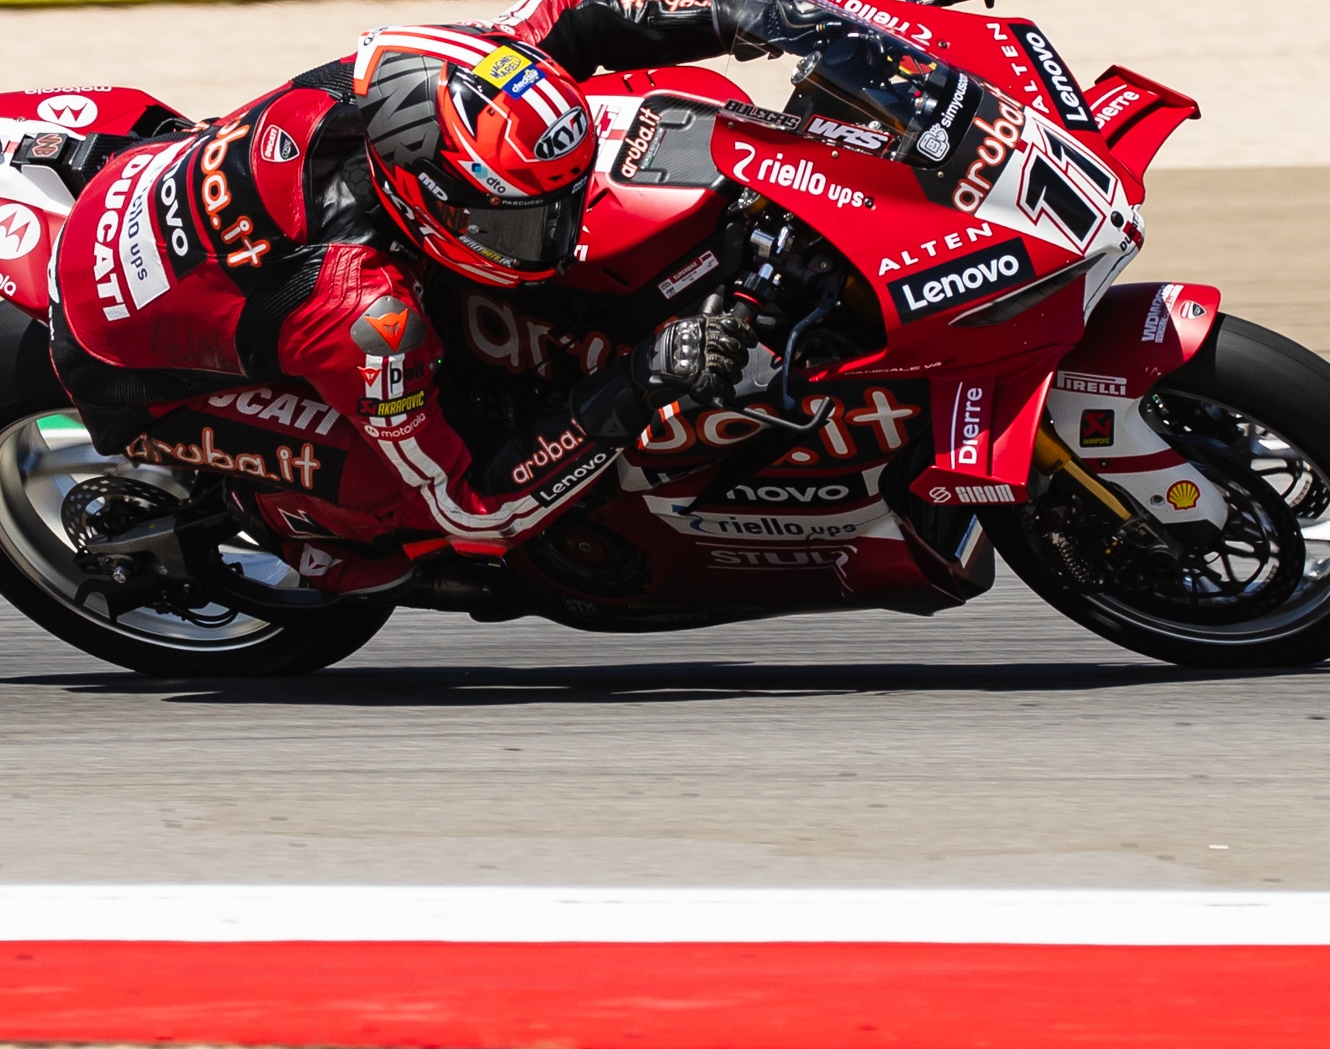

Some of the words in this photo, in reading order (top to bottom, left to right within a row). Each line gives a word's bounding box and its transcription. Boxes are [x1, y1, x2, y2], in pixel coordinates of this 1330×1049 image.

[986, 22, 1050, 114] ALTEN
[1026, 31, 1089, 124] Lenovo
[265, 128, 278, 158] DUCATI
[536, 109, 586, 160] KYT
[620, 105, 662, 179] aruba.it
[809, 118, 889, 150] WRS
[486, 175, 507, 195] dto
[501, 199, 545, 207] PASCUCCI
[757, 152, 827, 196] riello
[827, 183, 865, 208] ups
[1016, 120, 1120, 253] 11
[93, 153, 155, 322] DUCATI
[878, 222, 994, 276] ALTEN
[129, 246, 148, 281] ups
[902, 254, 1020, 311] Lenovo
[1057, 370, 1128, 396] PIRELLI
[381, 412, 427, 438] motorola
[959, 387, 983, 464] Dierre
[539, 453, 607, 501] Lenovo
[719, 516, 805, 536] riello
